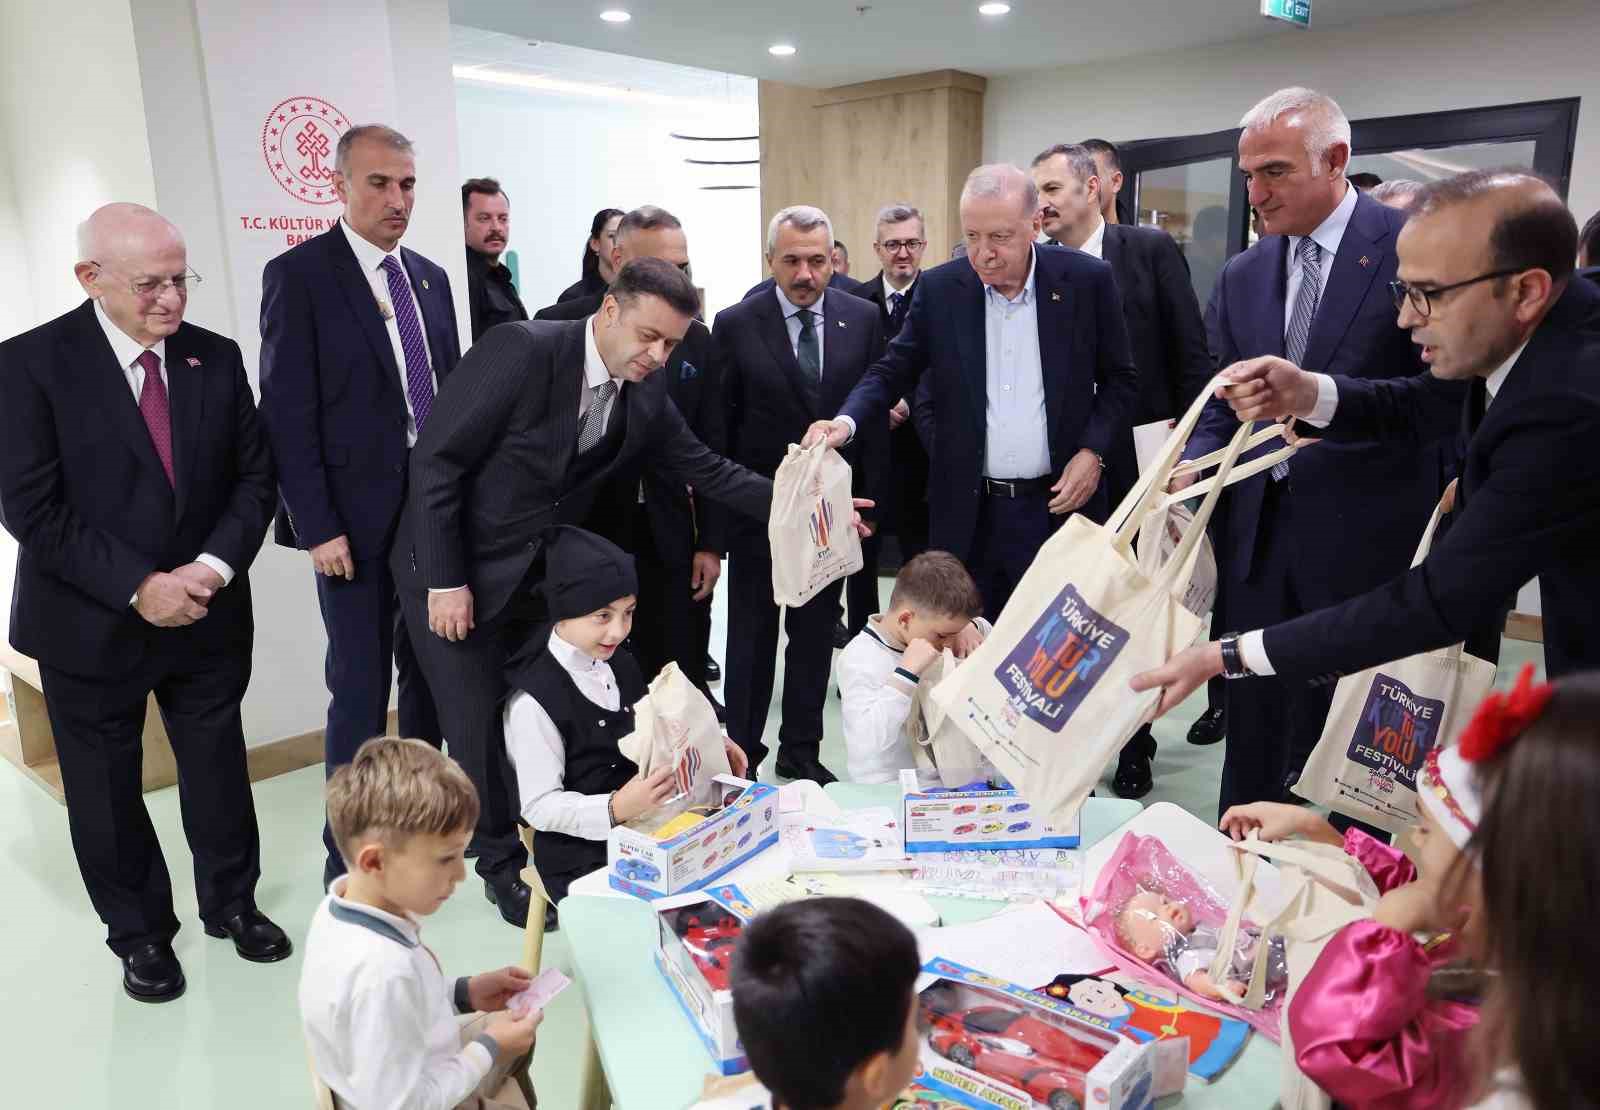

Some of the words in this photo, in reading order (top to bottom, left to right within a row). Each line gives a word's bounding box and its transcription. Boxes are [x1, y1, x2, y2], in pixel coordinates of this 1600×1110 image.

[240, 216, 266, 230] T.C.
[269, 215, 323, 231] KÜLTÜR
[1005, 663, 1064, 719] FESTİVALİ
[1380, 682, 1435, 720] TÜRKİYE
[1354, 744, 1417, 783] FESTİVALİ
